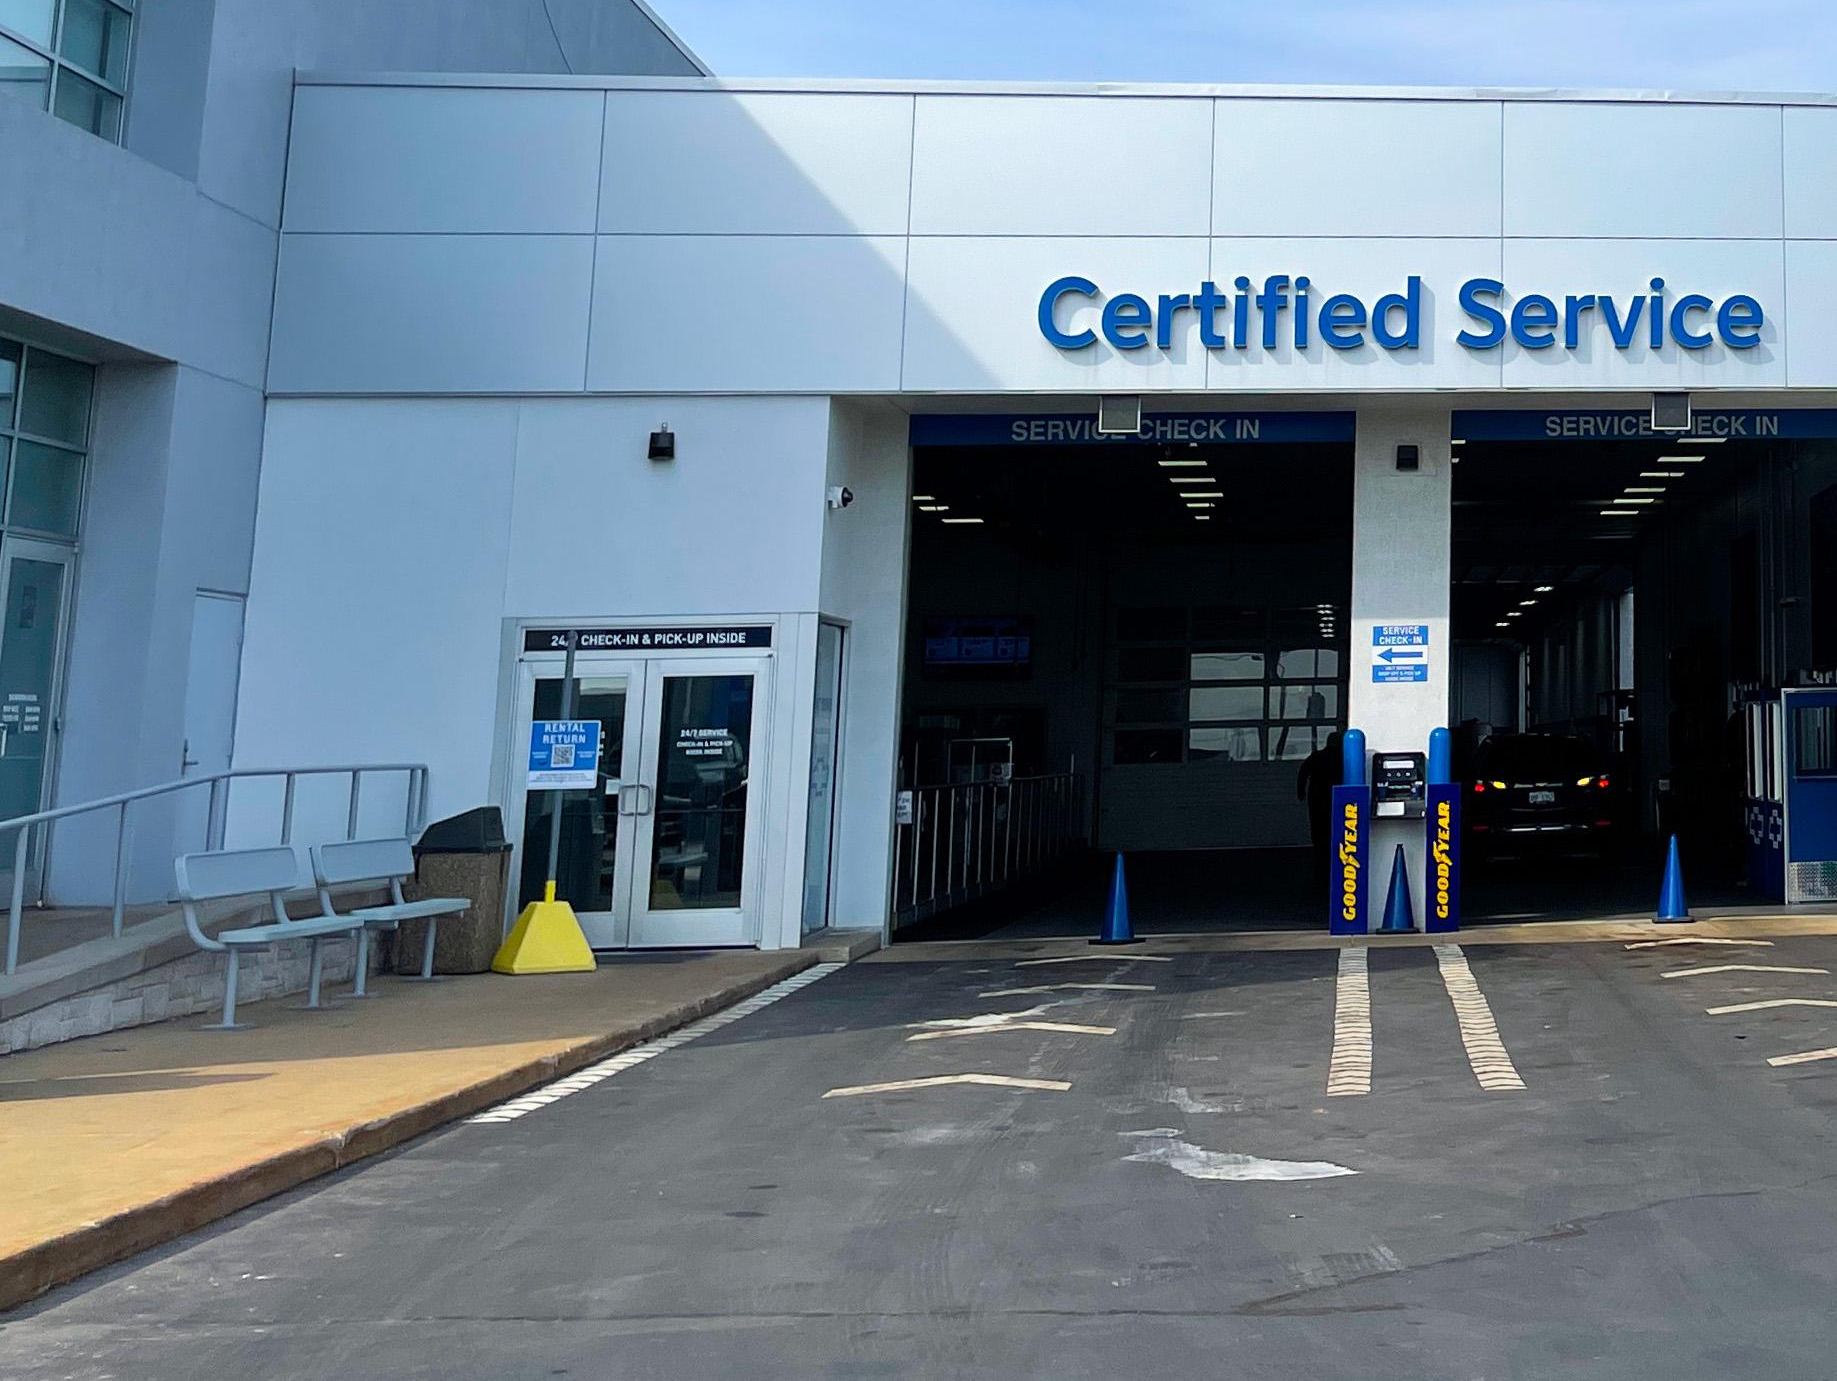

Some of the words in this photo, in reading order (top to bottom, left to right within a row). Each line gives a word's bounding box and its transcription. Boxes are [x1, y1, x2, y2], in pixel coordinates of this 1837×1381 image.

[1037, 275, 1421, 350] Certified
[1456, 277, 1764, 350] Service
[1137, 419, 1226, 441] CHECK
[1235, 419, 1260, 439] IN
[1545, 416, 1653, 437] SERVICE
[1755, 415, 1778, 436] IN
[581, 634, 639, 646] CHECK-IN
[642, 634, 651, 645] &
[654, 633, 704, 645] PICK-UP
[706, 632, 746, 644] INSIDE
[1382, 626, 1420, 635] SERVICE
[1379, 636, 1423, 645] CHECK-IN
[544, 723, 586, 733] RENTAL
[543, 734, 586, 744] RETURN
[1339, 803, 1360, 921] GOODYEAR
[1433, 801, 1452, 919] GOODYEAR
